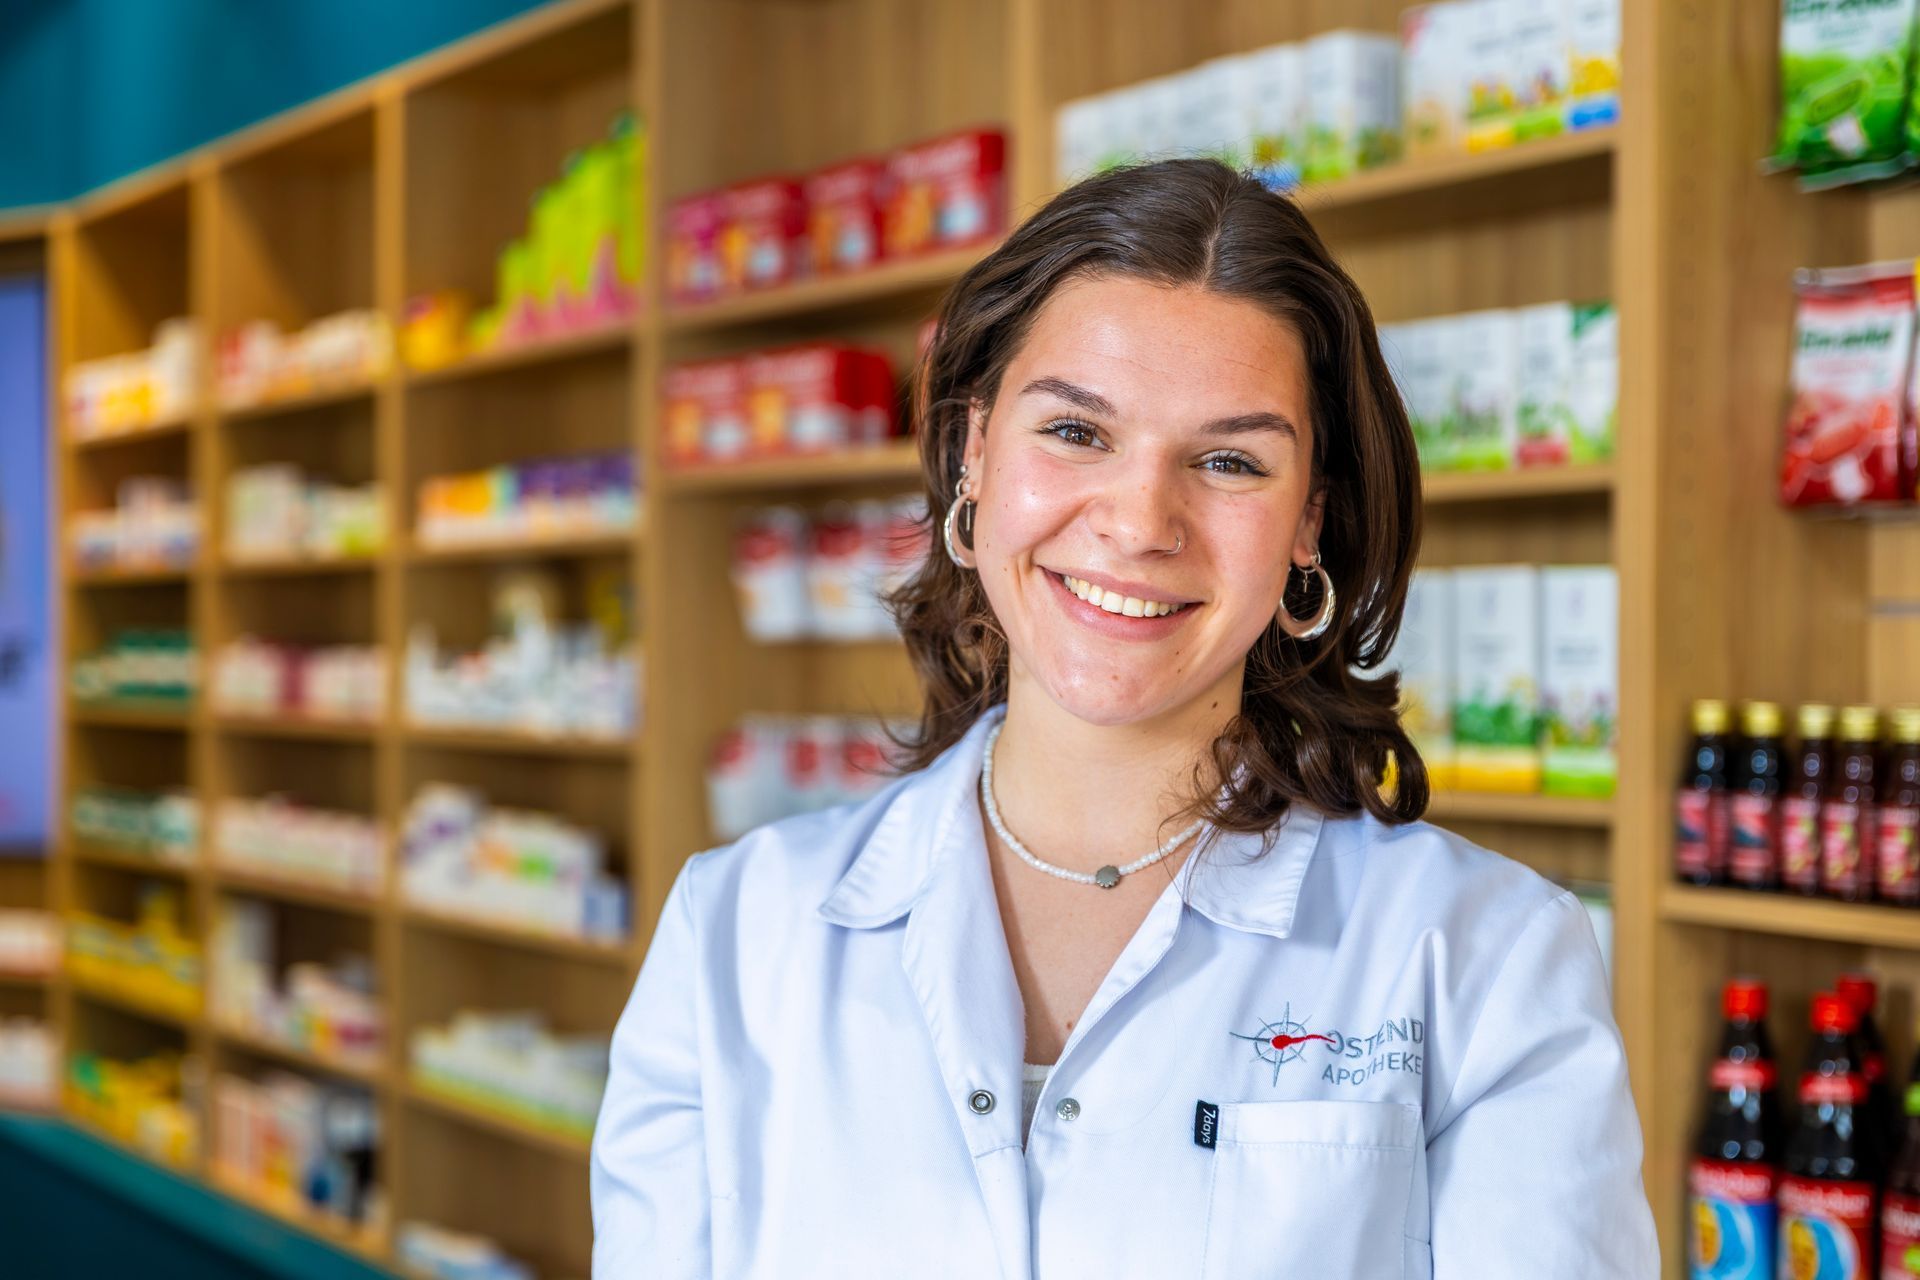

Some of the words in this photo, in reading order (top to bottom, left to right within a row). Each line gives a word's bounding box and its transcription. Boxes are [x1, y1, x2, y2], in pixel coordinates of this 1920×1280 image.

[1325, 1017, 1424, 1058] OSTEND
[1321, 1051, 1423, 1086] APOTHEKE
[1200, 1107, 1216, 1144] 7days
